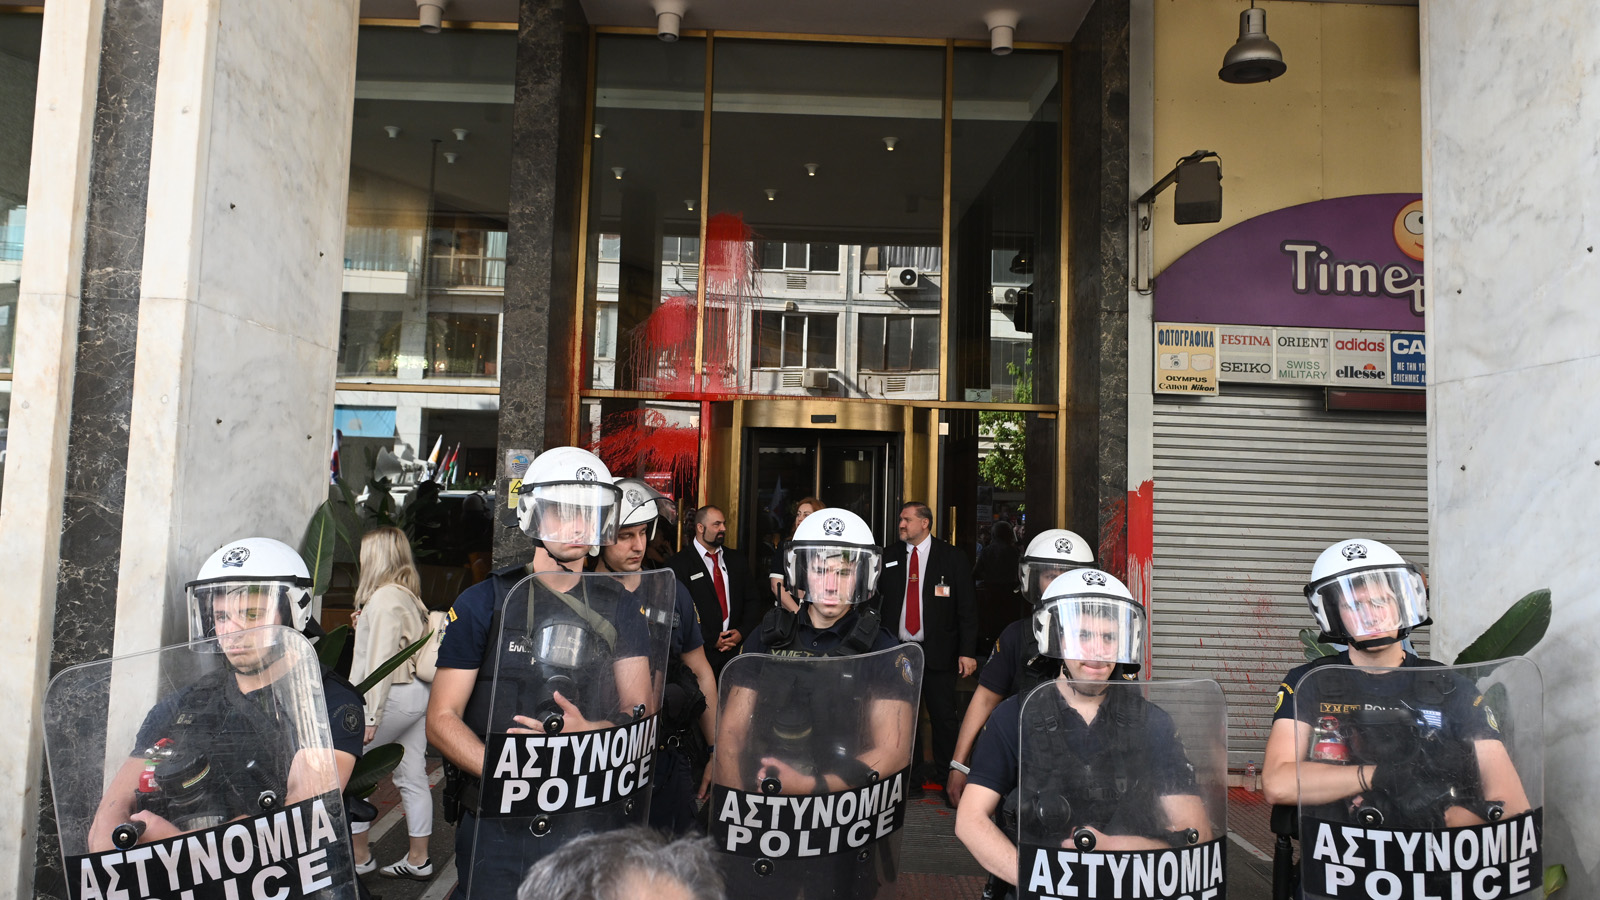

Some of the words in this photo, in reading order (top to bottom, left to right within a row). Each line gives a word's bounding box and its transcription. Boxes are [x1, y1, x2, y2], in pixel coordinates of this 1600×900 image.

[1158, 329, 1214, 348] ΦΩΤΟΓΡΑΦΙΚΑ
[1221, 334, 1271, 347] FESTINA
[1278, 336, 1328, 348] ORIENT
[1335, 337, 1385, 352] adidas
[1220, 361, 1271, 374] SEIKO
[1286, 360, 1320, 370] SWISS
[1335, 365, 1386, 380] ellesse
[1165, 375, 1208, 384] OLYMPUS
[1278, 369, 1328, 380] MILITARY
[1158, 382, 1188, 391] Canon
[1190, 384, 1215, 392] Nikon
[493, 714, 658, 779] ΑΣΤΥΝΟΜΙΑ
[500, 753, 652, 814] POLICE
[719, 772, 903, 830] ΑΣΤΥΝΟΜΙΑ
[726, 806, 896, 858] POLICE
[80, 799, 338, 900] ΑΣΤΥΝΟΜΙΑ
[1312, 815, 1538, 872] ΑΣΤΥΝΟΜΙΑ
[1028, 841, 1224, 899] ΑΣΤΥΝΟΜΙΑ
[1325, 856, 1531, 900] POLICE
